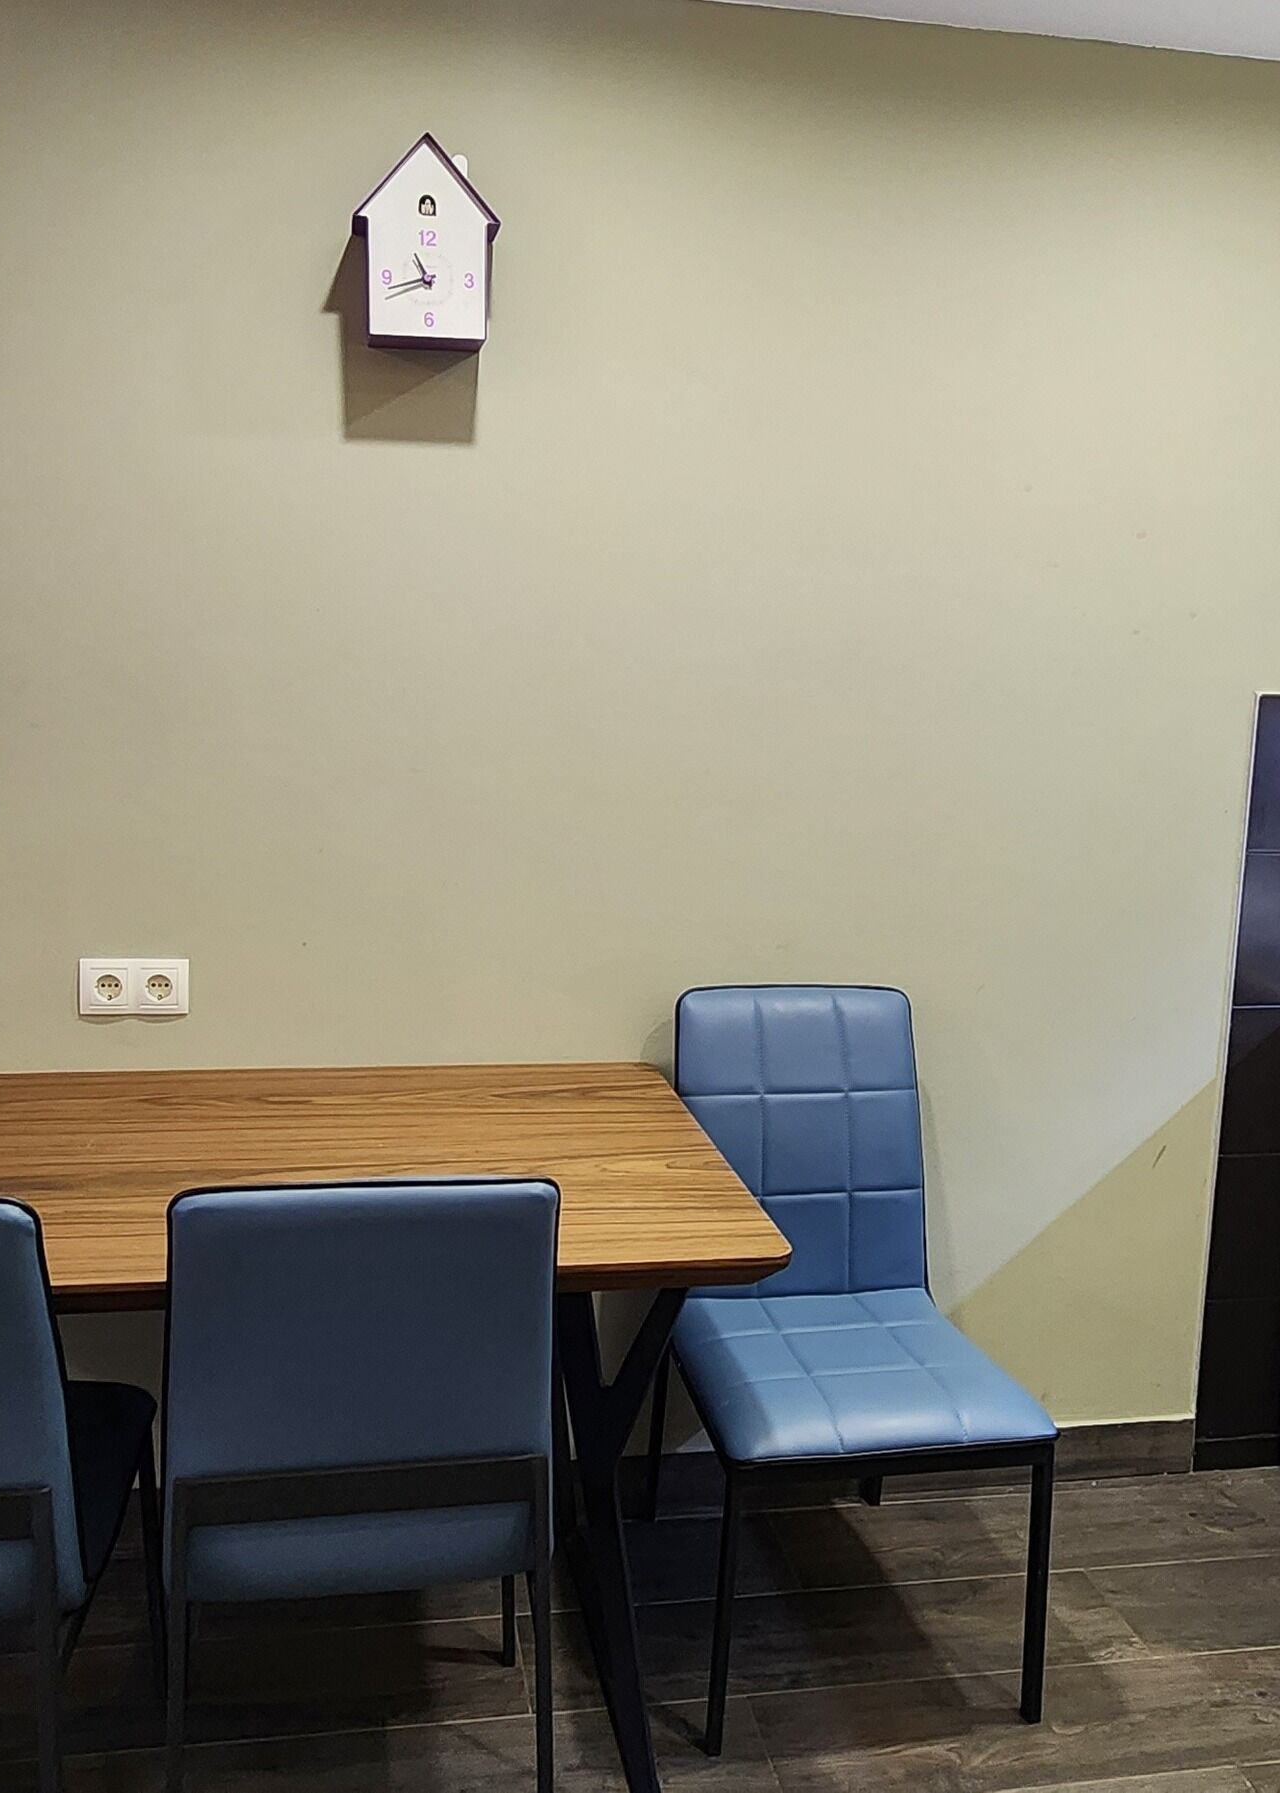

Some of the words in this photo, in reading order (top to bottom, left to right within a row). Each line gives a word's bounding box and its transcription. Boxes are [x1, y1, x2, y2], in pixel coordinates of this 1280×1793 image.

[418, 230, 437, 247] 12
[381, 269, 393, 285] 9
[464, 273, 475, 289] 3
[424, 312, 435, 328] 6
